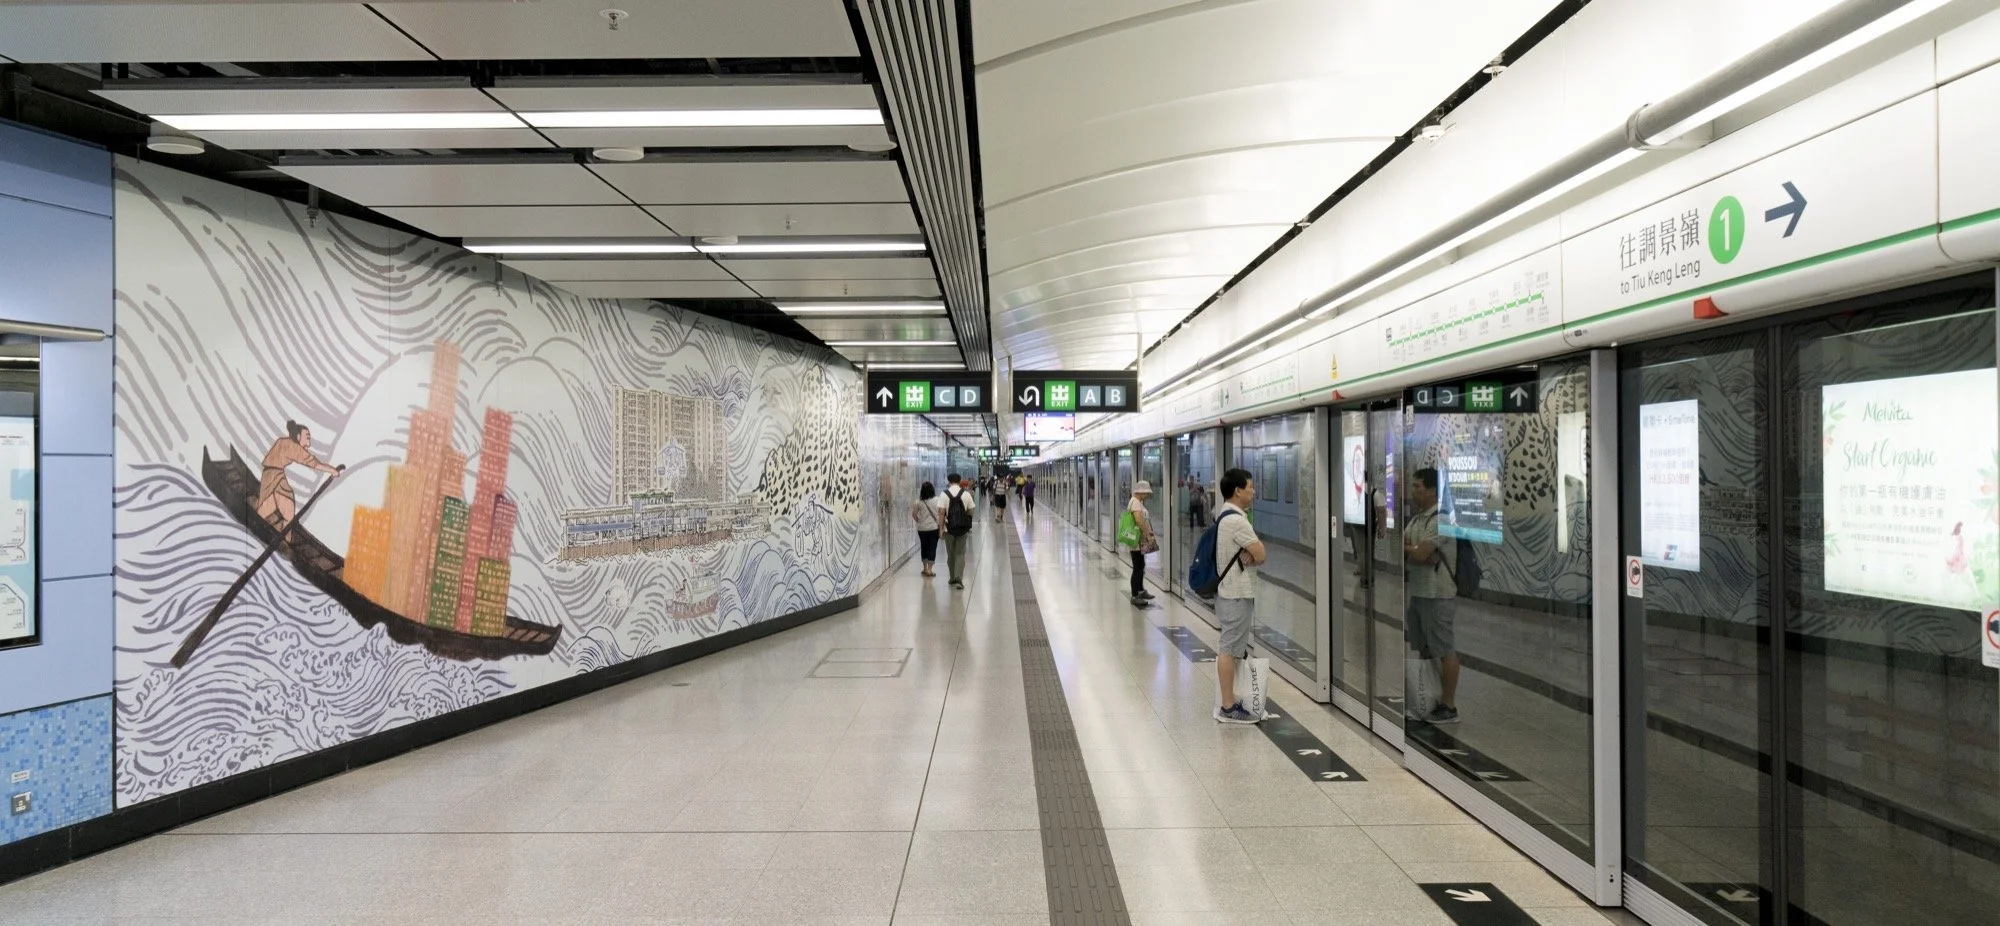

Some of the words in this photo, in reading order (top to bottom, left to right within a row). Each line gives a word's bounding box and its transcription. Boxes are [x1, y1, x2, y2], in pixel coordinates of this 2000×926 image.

[1620, 208, 1699, 271] 往調景嶺
[1719, 208, 1730, 251] 1
[1620, 281, 1630, 295] to
[1631, 273, 1646, 292] Tiu
[1648, 268, 1673, 287] Keng
[1675, 259, 1700, 279] Leng
[939, 389, 951, 404] C
[964, 389, 977, 404] D
[1084, 389, 1096, 403] A
[1110, 389, 1121, 403] B
[1862, 401, 1914, 422] Melvita
[1448, 456, 1477, 470] YOUSSOU
[1842, 441, 1876, 471] Start
[1880, 438, 1938, 478] Organic
[1251, 667, 1259, 692] STYLE
